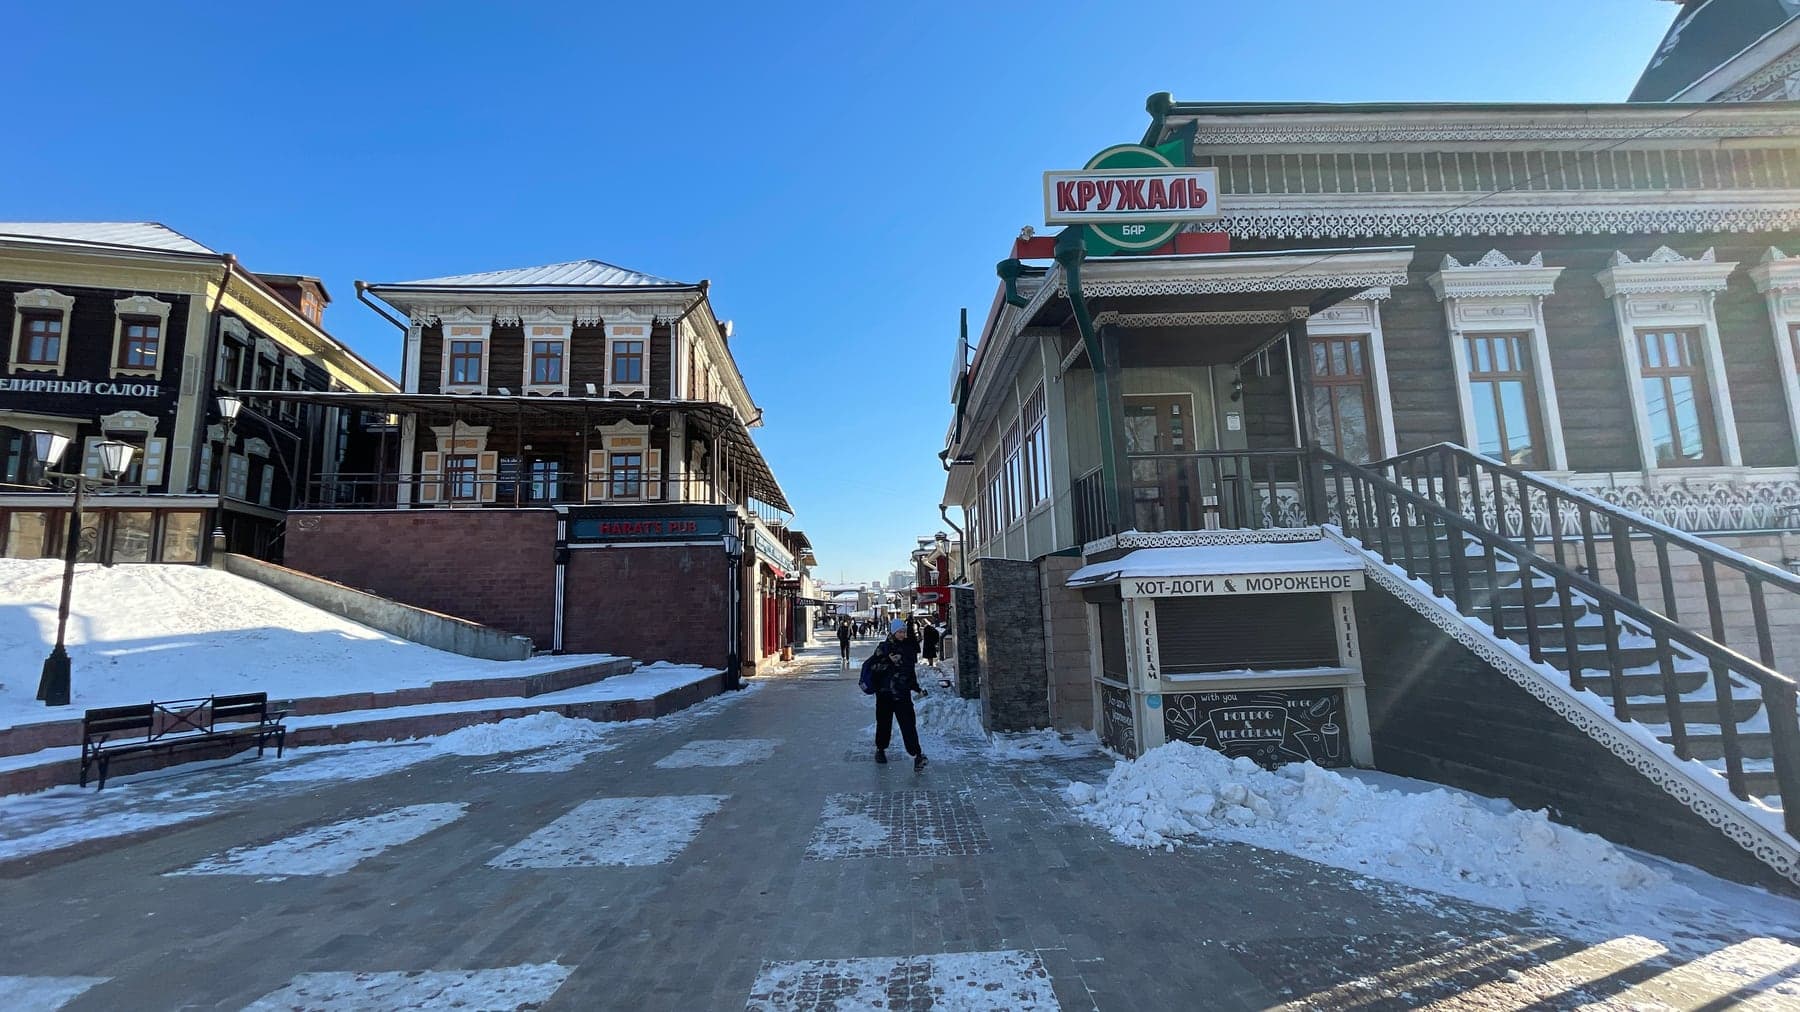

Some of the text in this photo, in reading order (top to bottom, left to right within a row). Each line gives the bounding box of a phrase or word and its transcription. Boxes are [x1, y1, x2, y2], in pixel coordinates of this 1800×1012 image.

[1056, 178, 1208, 212] КРУЖАЛЬ
[1122, 225, 1146, 236] БАР
[95, 383, 159, 397] САЛОН
[668, 520, 697, 532] PUB
[1135, 575, 1351, 595] ХОТ-ДОГИ & МОРОЖЕНОЕ
[1200, 693, 1238, 703] with you
[1223, 710, 1274, 721] HOT DOG
[1219, 728, 1282, 739] ICE CREAM
